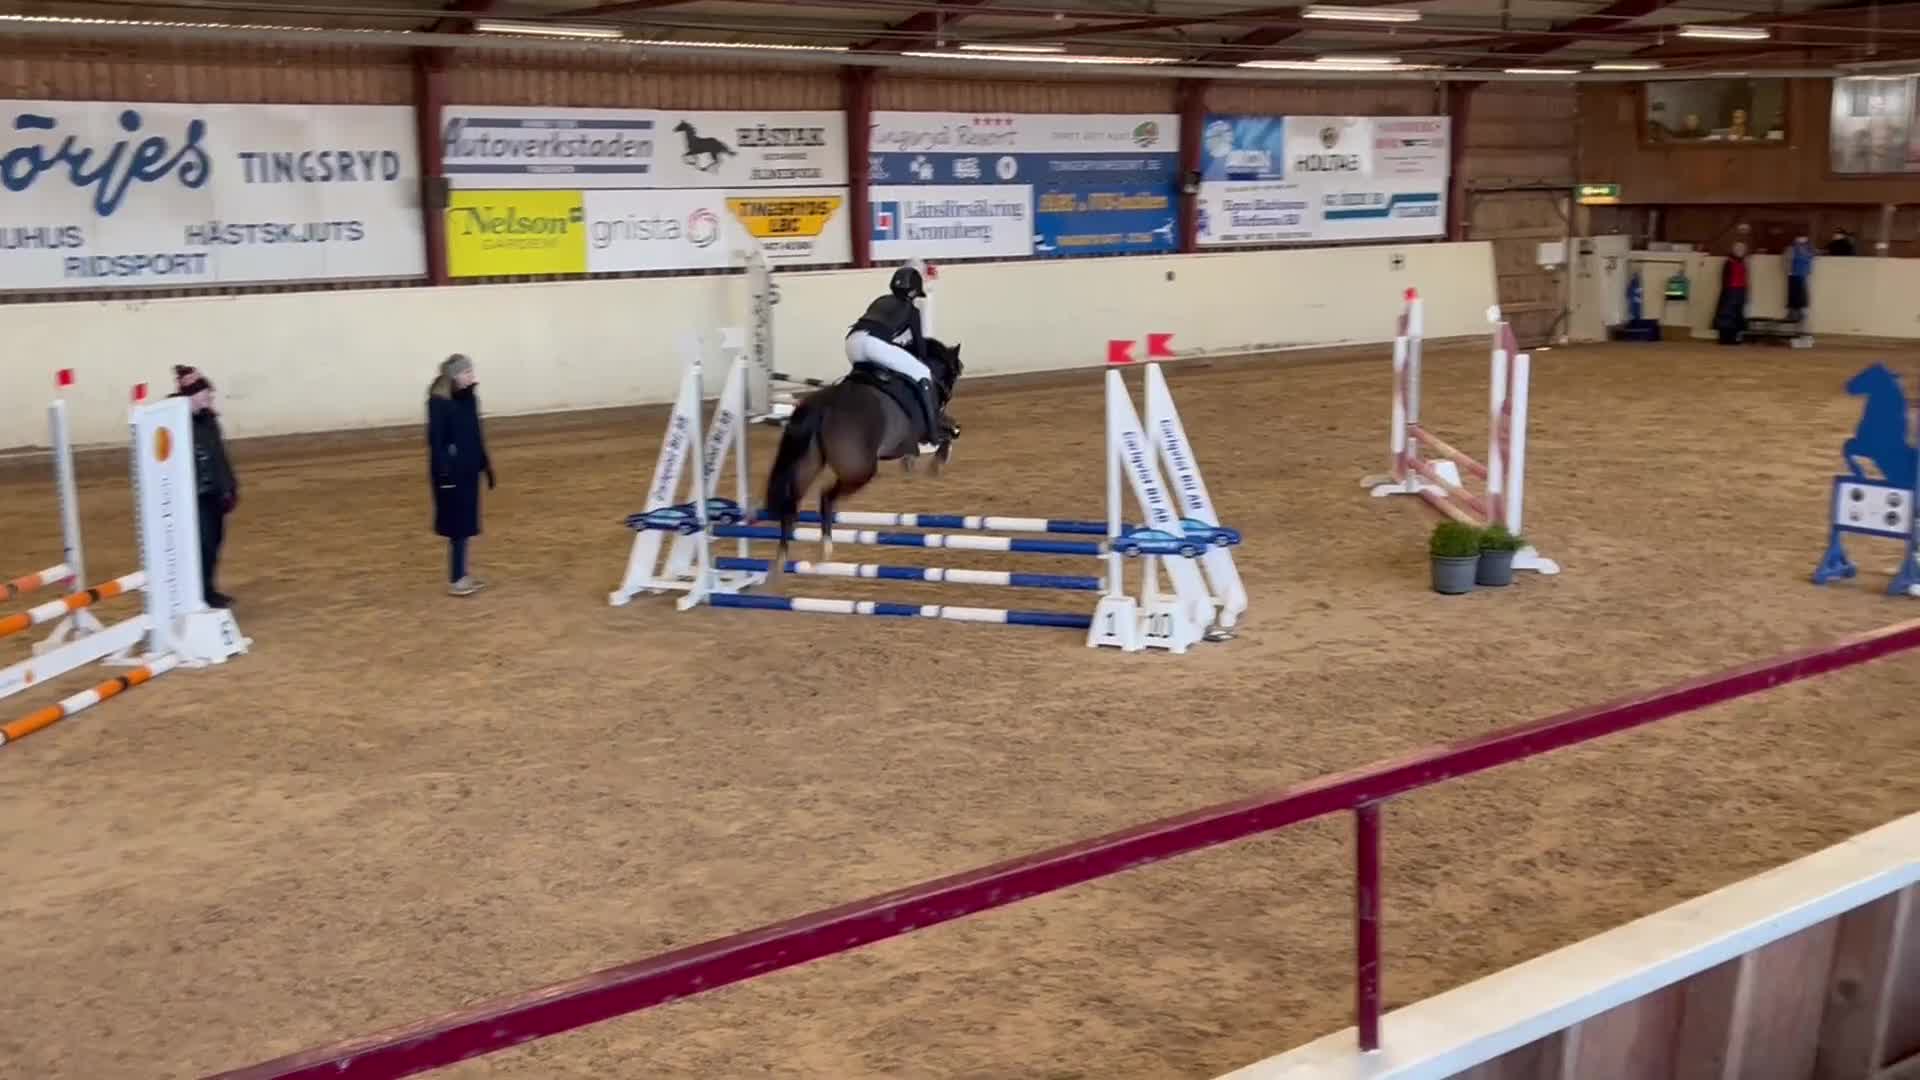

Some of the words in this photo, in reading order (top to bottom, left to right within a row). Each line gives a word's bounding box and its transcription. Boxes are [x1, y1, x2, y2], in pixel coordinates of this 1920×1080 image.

[441, 117, 653, 160] Autoverkstaden
[238, 150, 401, 184] TINGSRYD
[184, 220, 365, 246] HÄSTSKJUTS
[449, 206, 569, 235] Nelson
[591, 214, 681, 249] gnista
[64, 254, 208, 278] RIDSPORT
